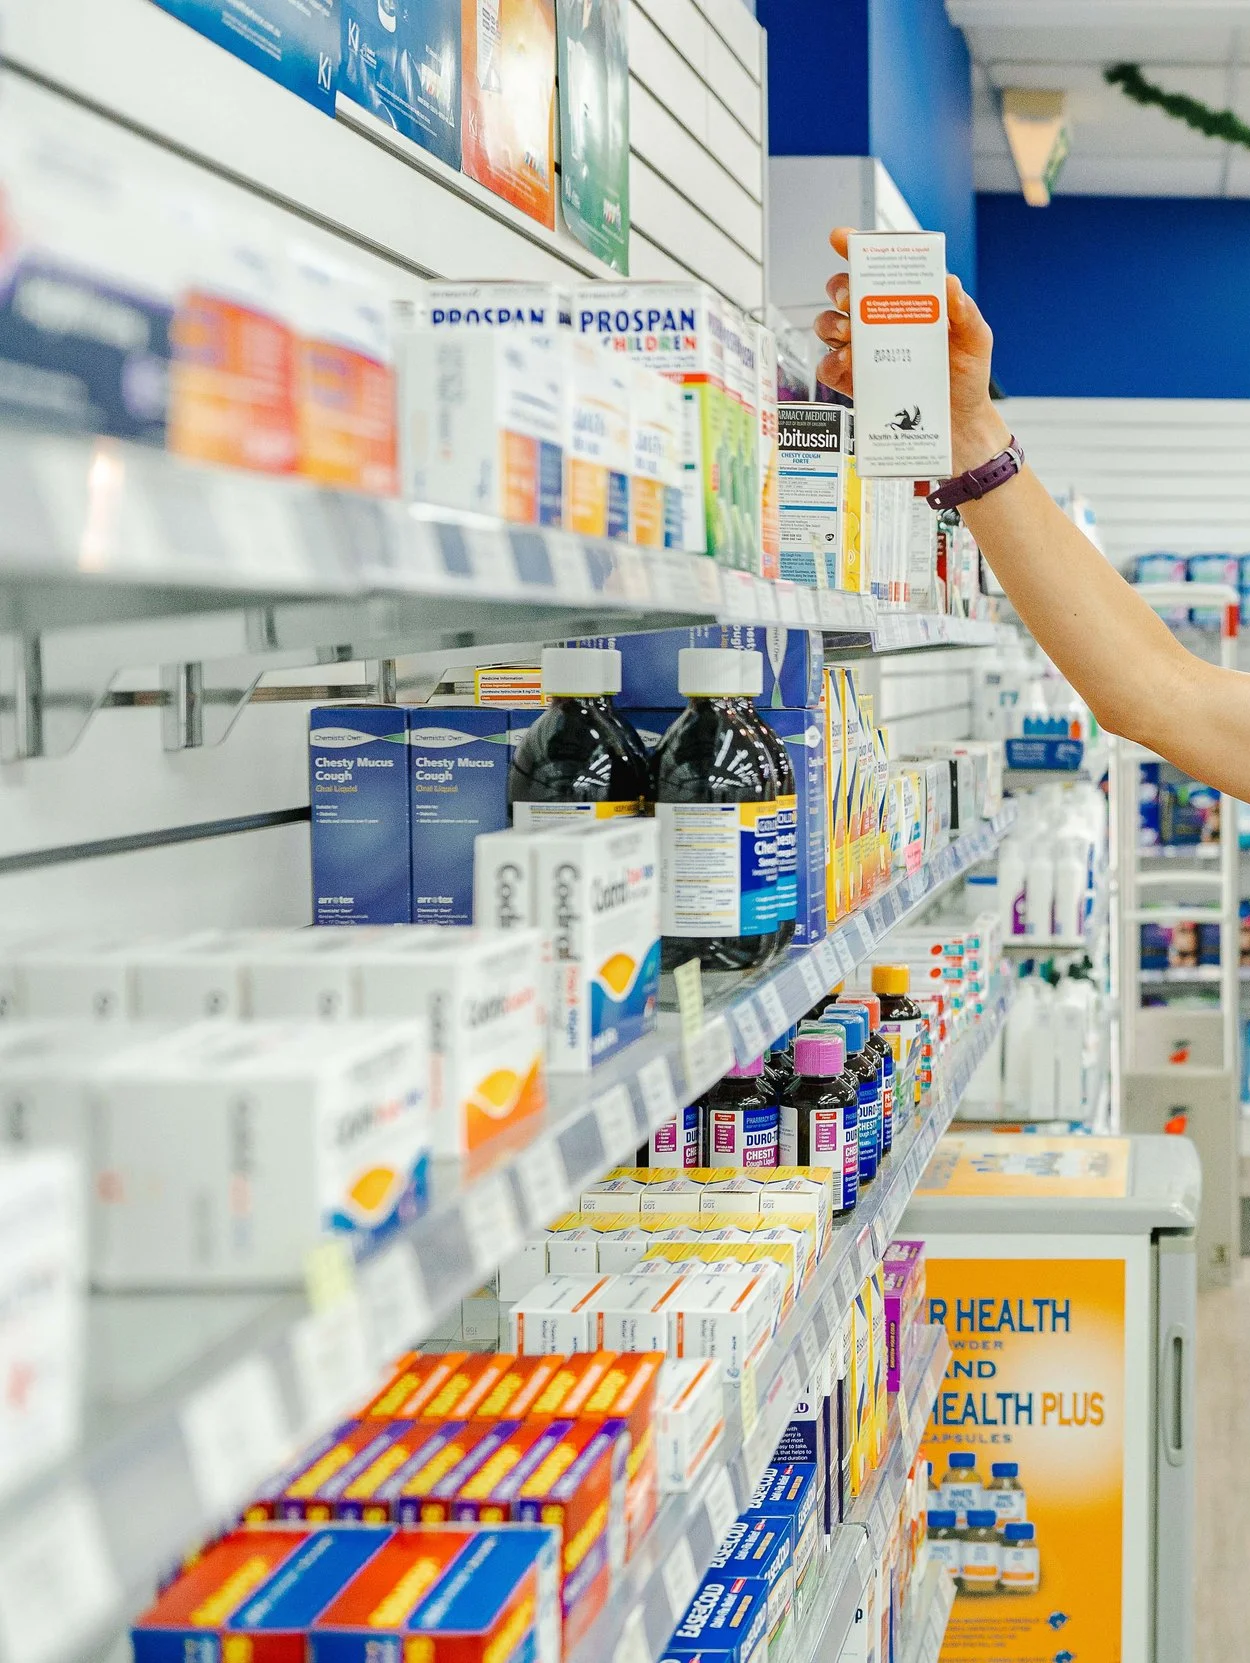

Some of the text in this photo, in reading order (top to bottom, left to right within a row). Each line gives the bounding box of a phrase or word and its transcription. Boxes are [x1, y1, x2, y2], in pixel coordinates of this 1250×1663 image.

[317, 52, 332, 90] Ki
[580, 308, 697, 333] PROSPAN
[778, 411, 837, 422] ARMACY MEDICINE
[777, 428, 838, 448] obitussin
[731, 624, 745, 650] ough
[315, 757, 394, 770] Chesty Mucus
[416, 757, 495, 770] Chesty Mucus
[315, 770, 352, 783] Cough
[416, 770, 453, 783] Cough
[315, 784, 358, 793] Oral Liquid
[416, 784, 458, 793] Oral Liquid
[754, 840, 777, 855] Ches
[746, 1131, 777, 1146] DURO-T
[746, 1148, 774, 1161] CHESTY
[763, 1158, 775, 1167] Liquid
[929, 1298, 1071, 1333] R HEALTH
[951, 1340, 1004, 1350] WDER
[944, 1360, 997, 1378] ND
[1041, 1391, 1105, 1427] PLUS
